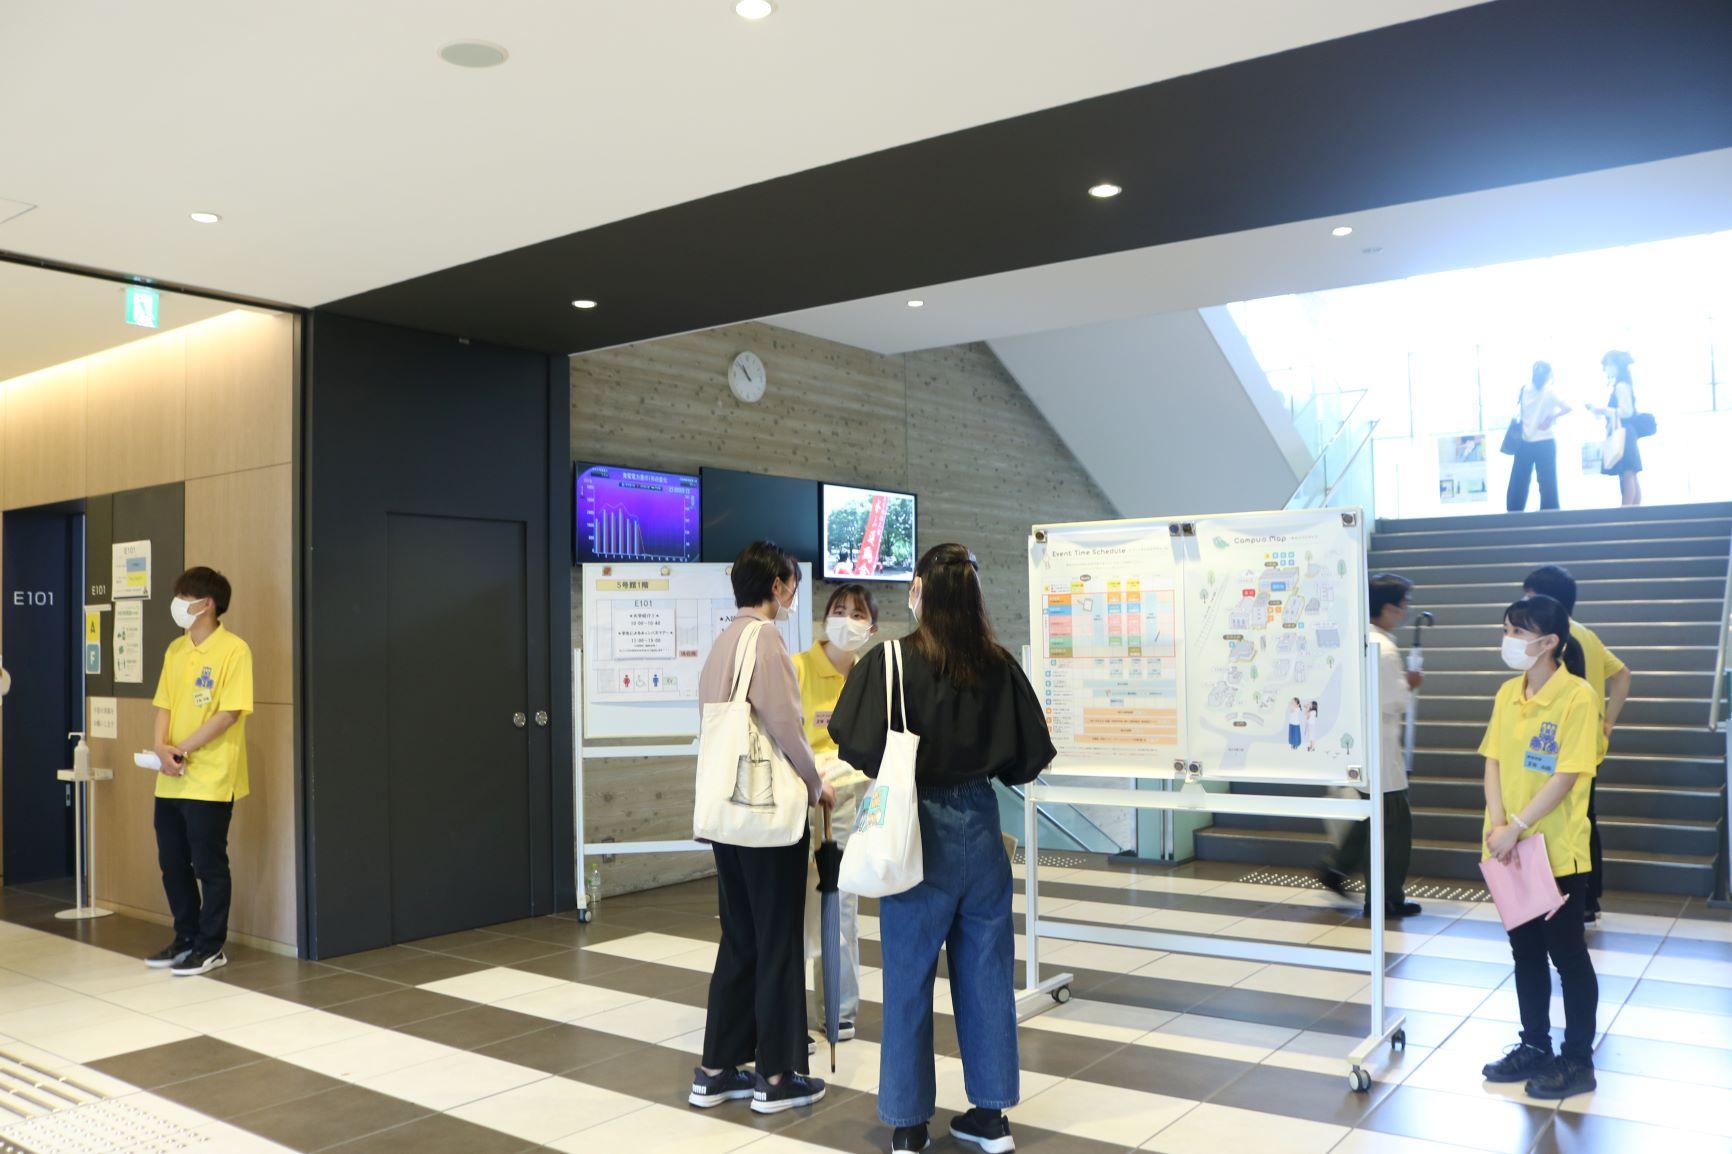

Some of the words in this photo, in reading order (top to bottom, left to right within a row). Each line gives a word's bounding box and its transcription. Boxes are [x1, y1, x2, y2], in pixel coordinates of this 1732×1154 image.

[1269, 535, 1287, 543] Map
[1052, 550, 1072, 558] Event
[1092, 547, 1126, 556] Schedule
[91, 585, 106, 596] E101
[13, 591, 54, 606] E101
[634, 600, 653, 608] E101
[90, 621, 96, 633] A
